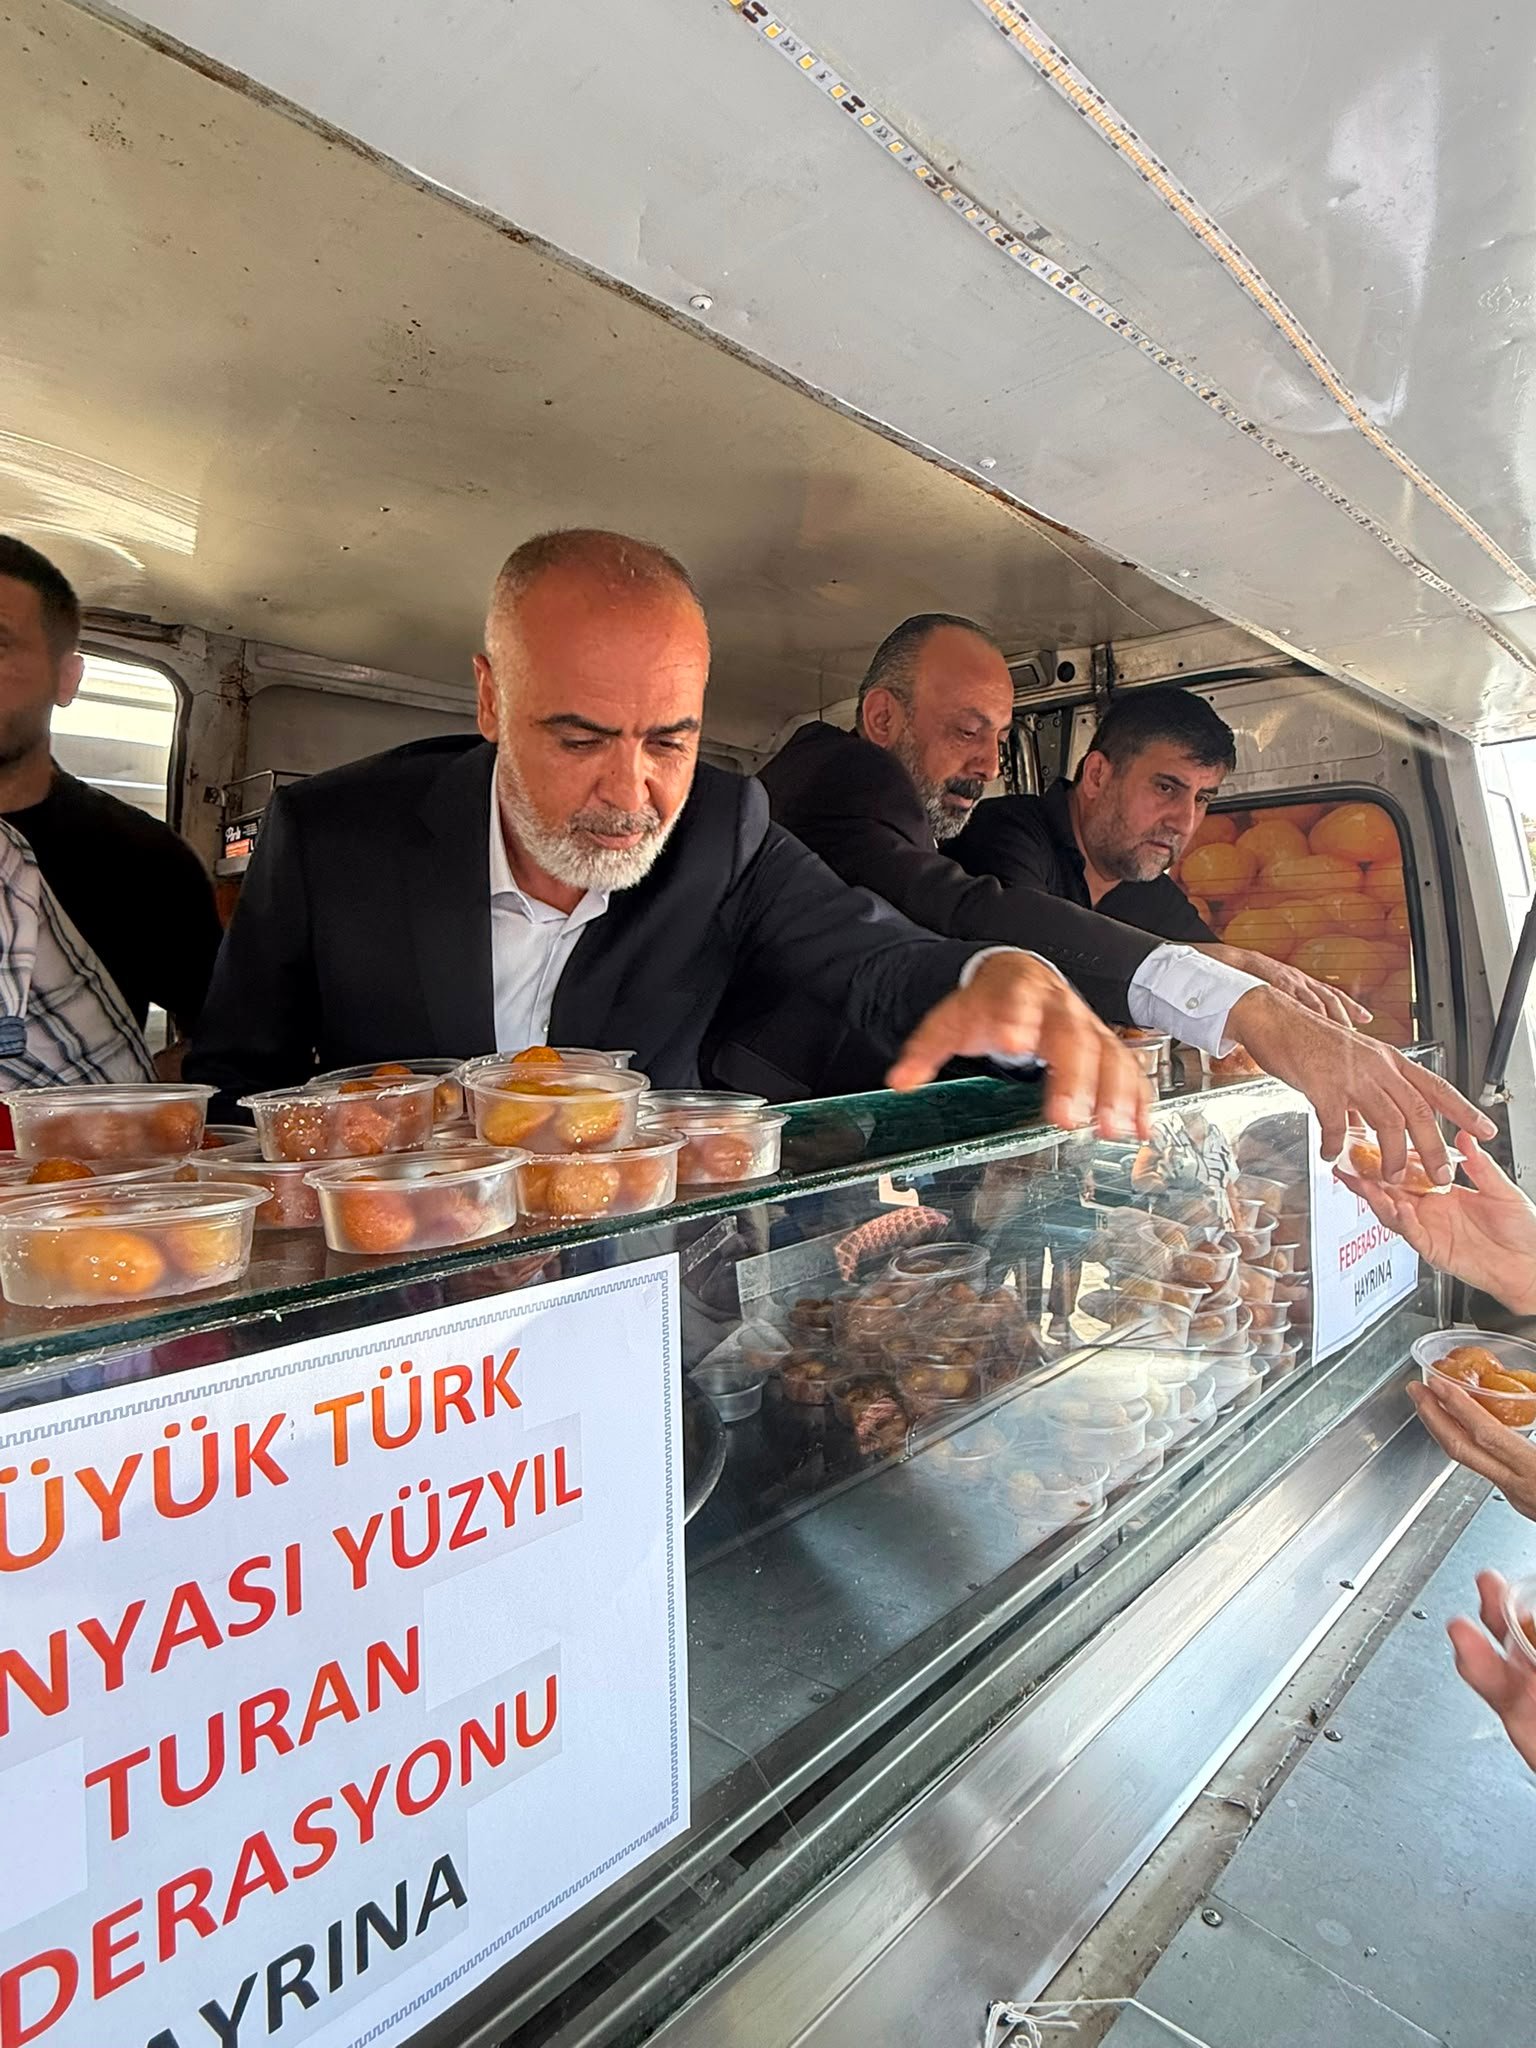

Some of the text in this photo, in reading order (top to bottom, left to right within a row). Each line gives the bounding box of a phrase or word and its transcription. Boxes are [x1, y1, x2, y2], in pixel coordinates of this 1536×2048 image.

[1354, 1259, 1392, 1306] HAYRINA
[0, 1348, 522, 1573] ÜYÜK TÜRK
[0, 1446, 583, 1737] NYASI YÜZYIL
[85, 1627, 420, 1841] TURAN
[0, 1675, 558, 2048] DERASYONU
[147, 1853, 468, 2048] YRINA
